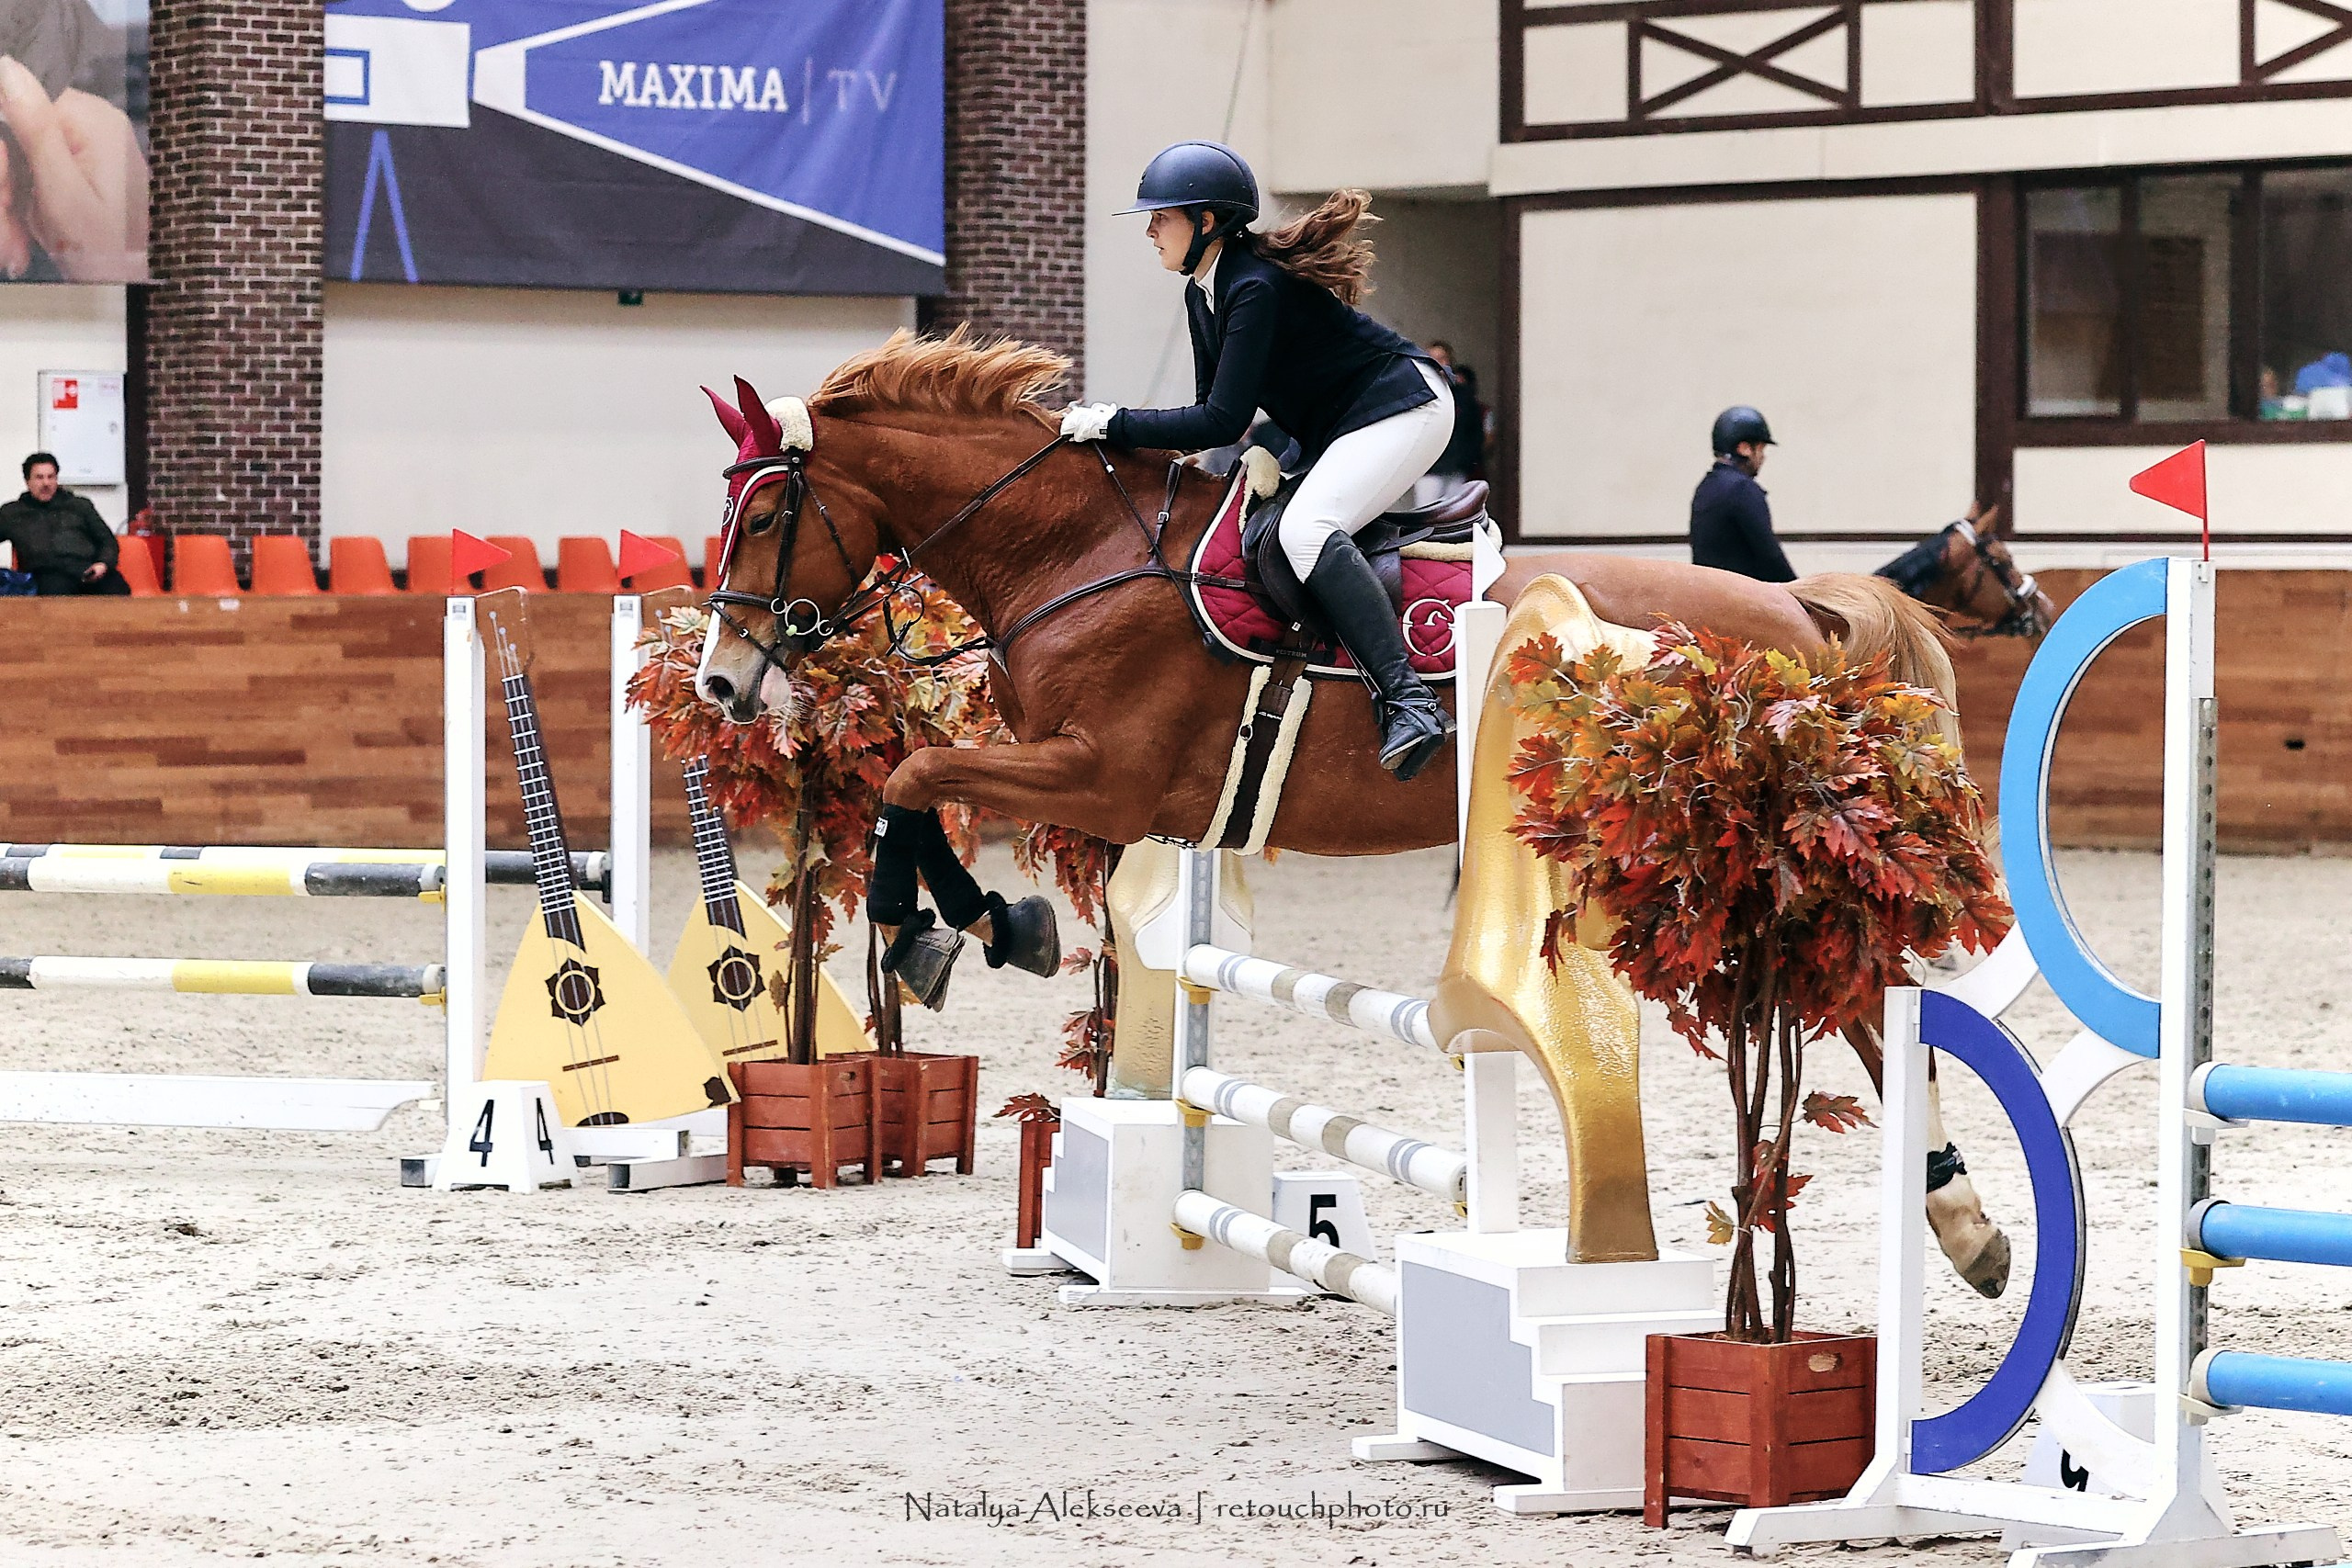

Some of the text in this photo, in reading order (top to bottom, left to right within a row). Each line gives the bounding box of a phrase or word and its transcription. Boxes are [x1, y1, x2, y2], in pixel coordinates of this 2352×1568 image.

[598, 60, 898, 112] MAXIMA TV
[469, 1099, 495, 1168] 4
[536, 1097, 554, 1166] 4
[1308, 1193, 1340, 1249] 5
